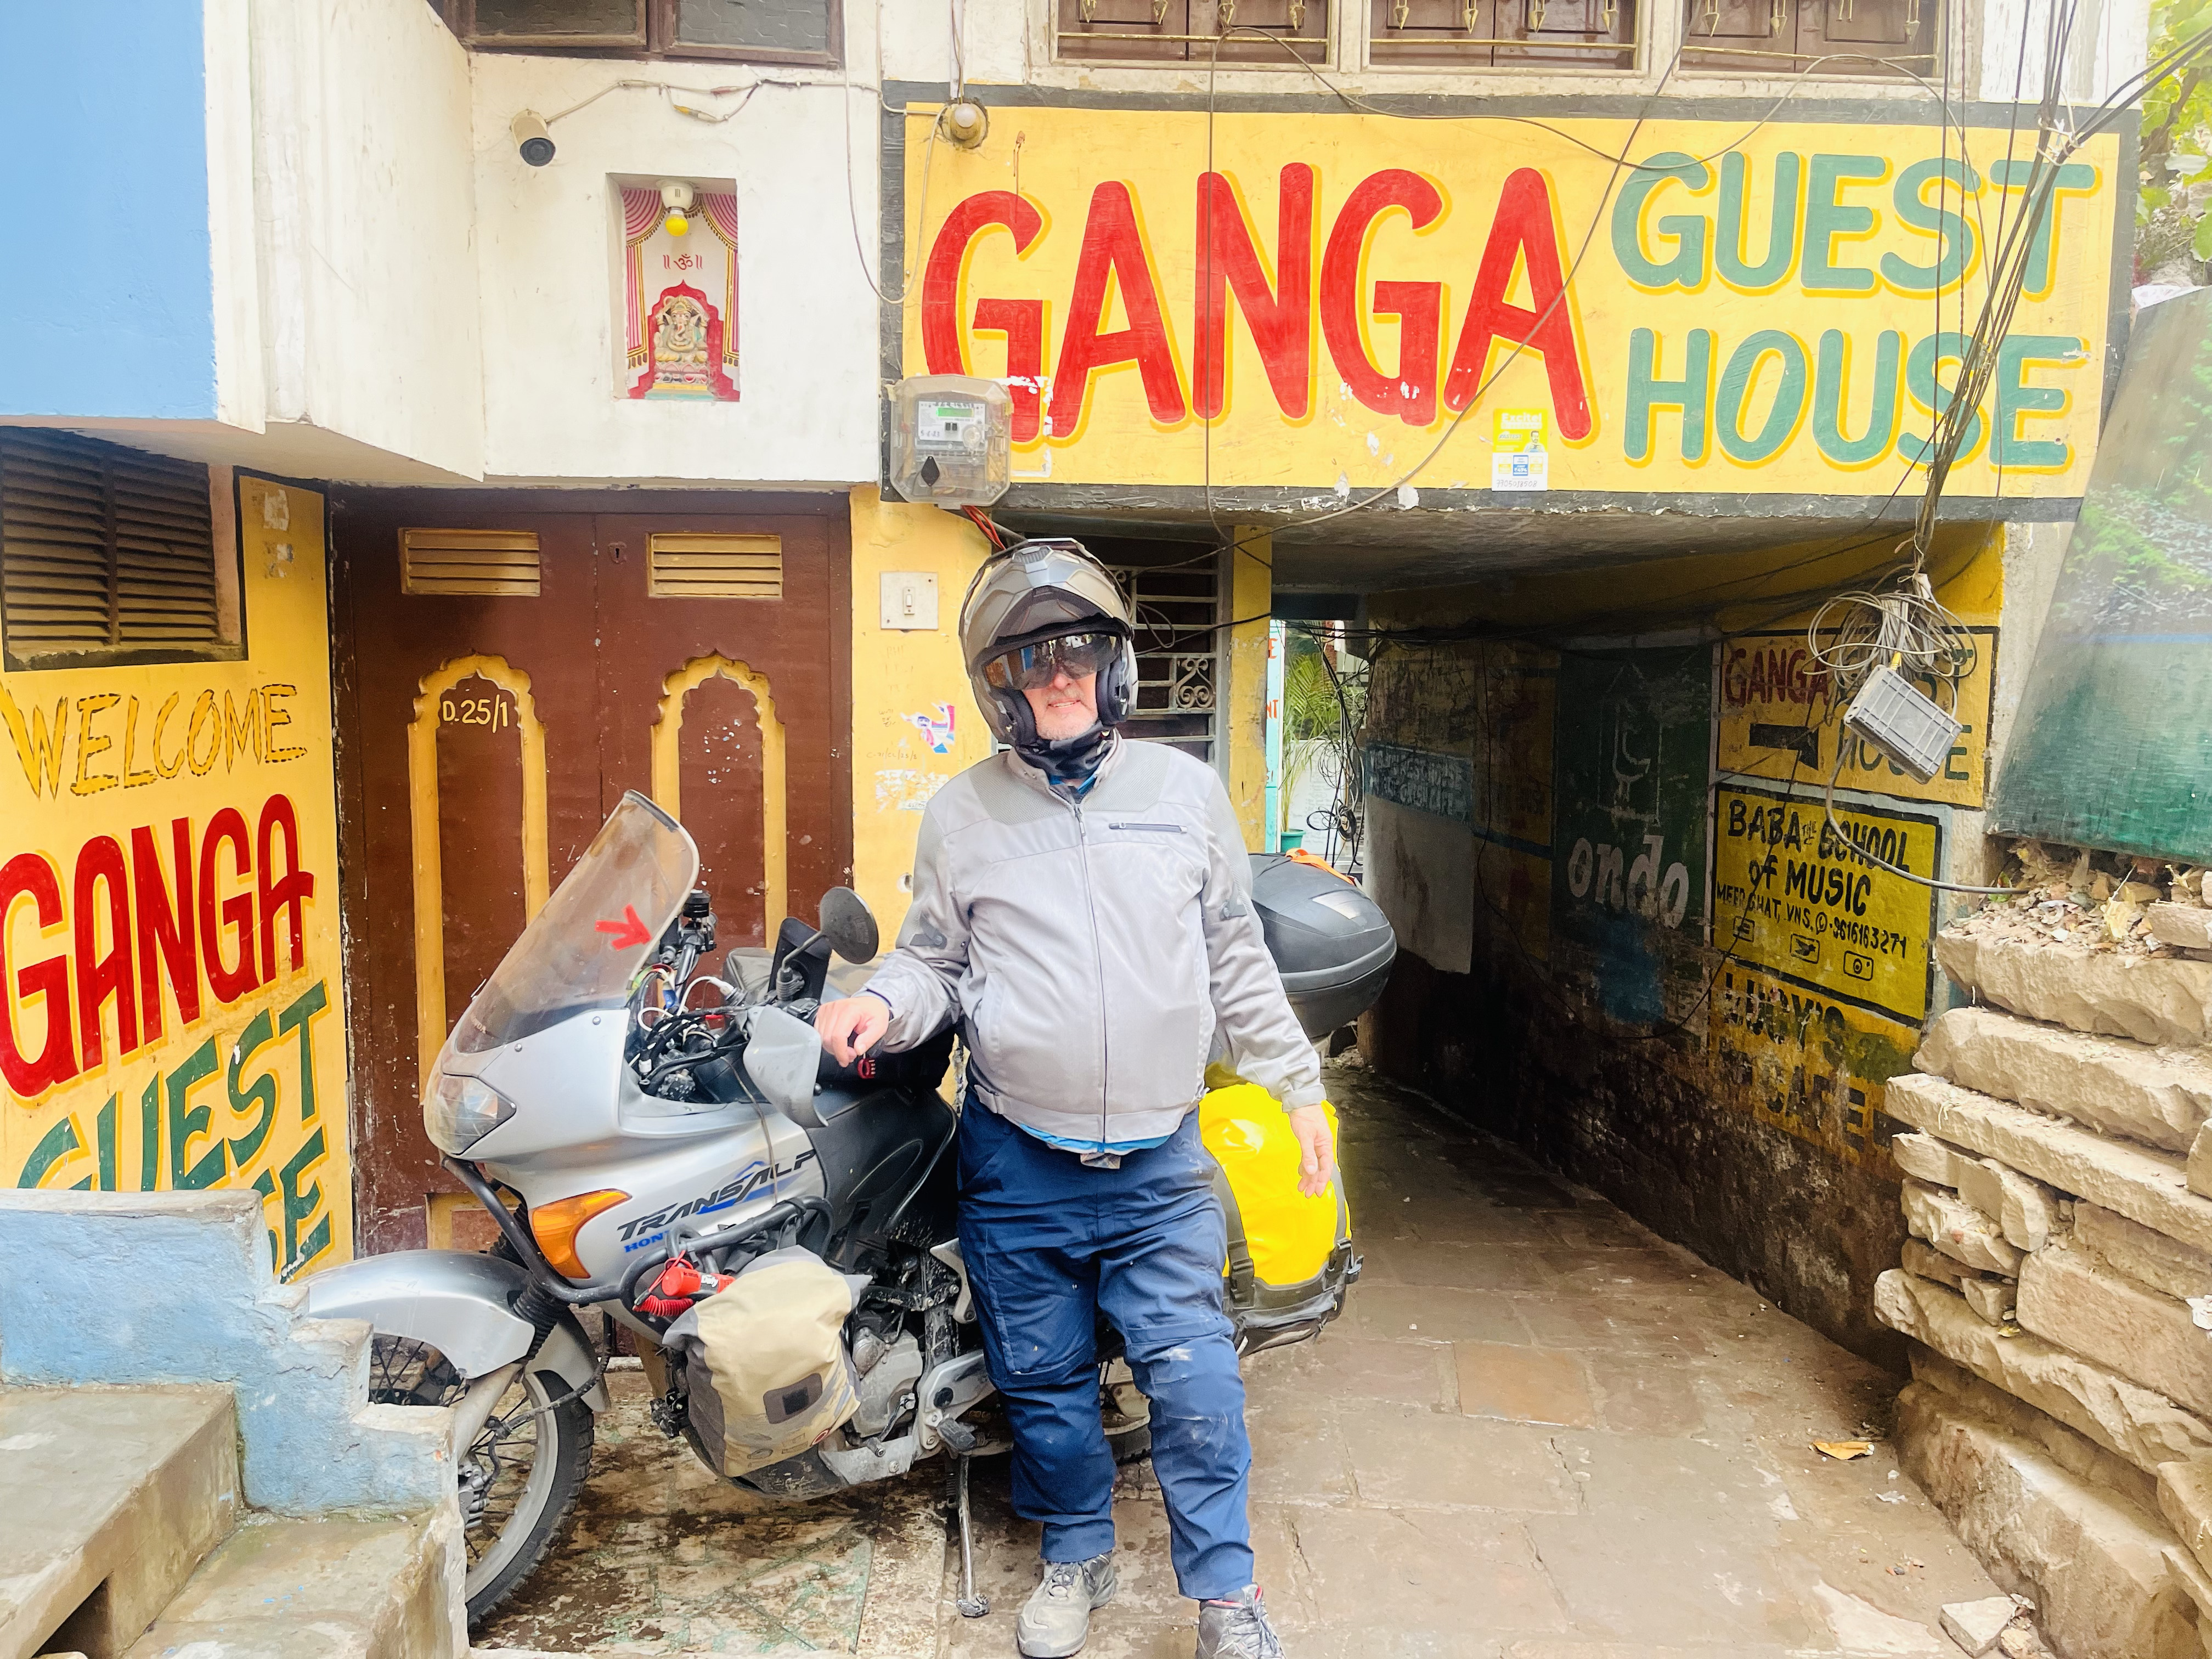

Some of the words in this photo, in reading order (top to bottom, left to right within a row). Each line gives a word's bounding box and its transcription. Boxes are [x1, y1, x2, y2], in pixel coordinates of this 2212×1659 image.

[1612, 151, 2096, 294] GUEST
[921, 162, 1591, 442] GANGA
[1502, 413, 1542, 422] Excitel
[1624, 328, 2083, 465] HOUSE
[1724, 648, 1829, 707] GANGA
[0, 684, 308, 799] WELCOME
[1728, 799, 1802, 853] BABA
[1818, 819, 1910, 873] SCHOOL
[1785, 859, 1871, 917] MUSIC
[0, 794, 314, 1097] GANGA
[617, 1149, 816, 1242] TRANSALP
